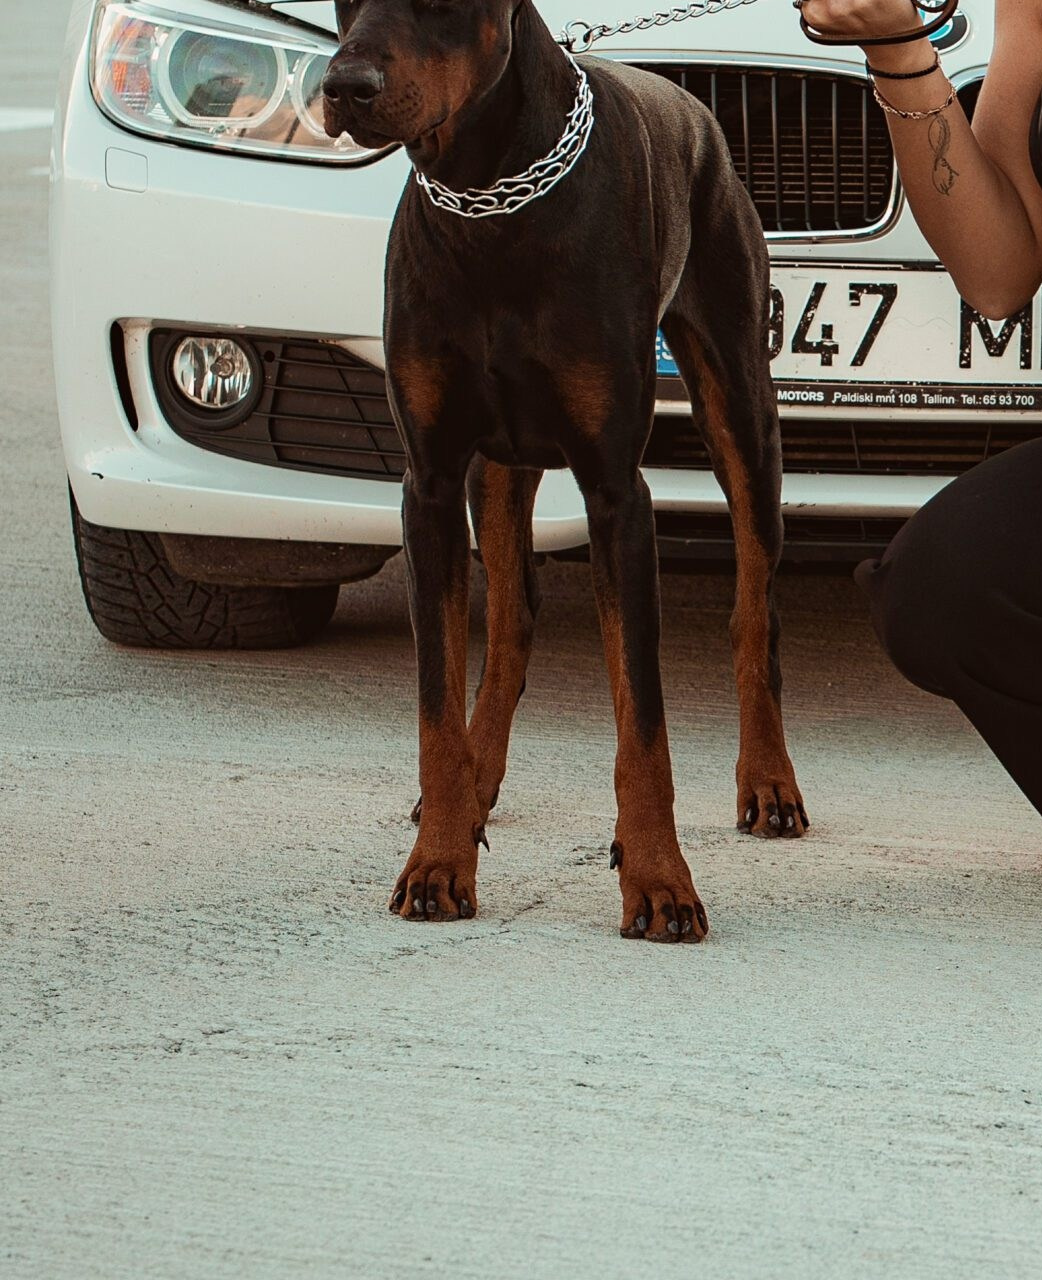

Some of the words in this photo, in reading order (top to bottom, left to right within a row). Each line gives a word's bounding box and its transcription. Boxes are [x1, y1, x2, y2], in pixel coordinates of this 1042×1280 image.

[777, 390, 824, 402] MOTORS
[833, 391, 874, 403] Paldiski
[875, 393, 896, 403] mnt
[898, 393, 918, 404] 108
[921, 393, 956, 404] Tallinn
[998, 394, 1013, 405] 93
[1014, 395, 1036, 405] 700
